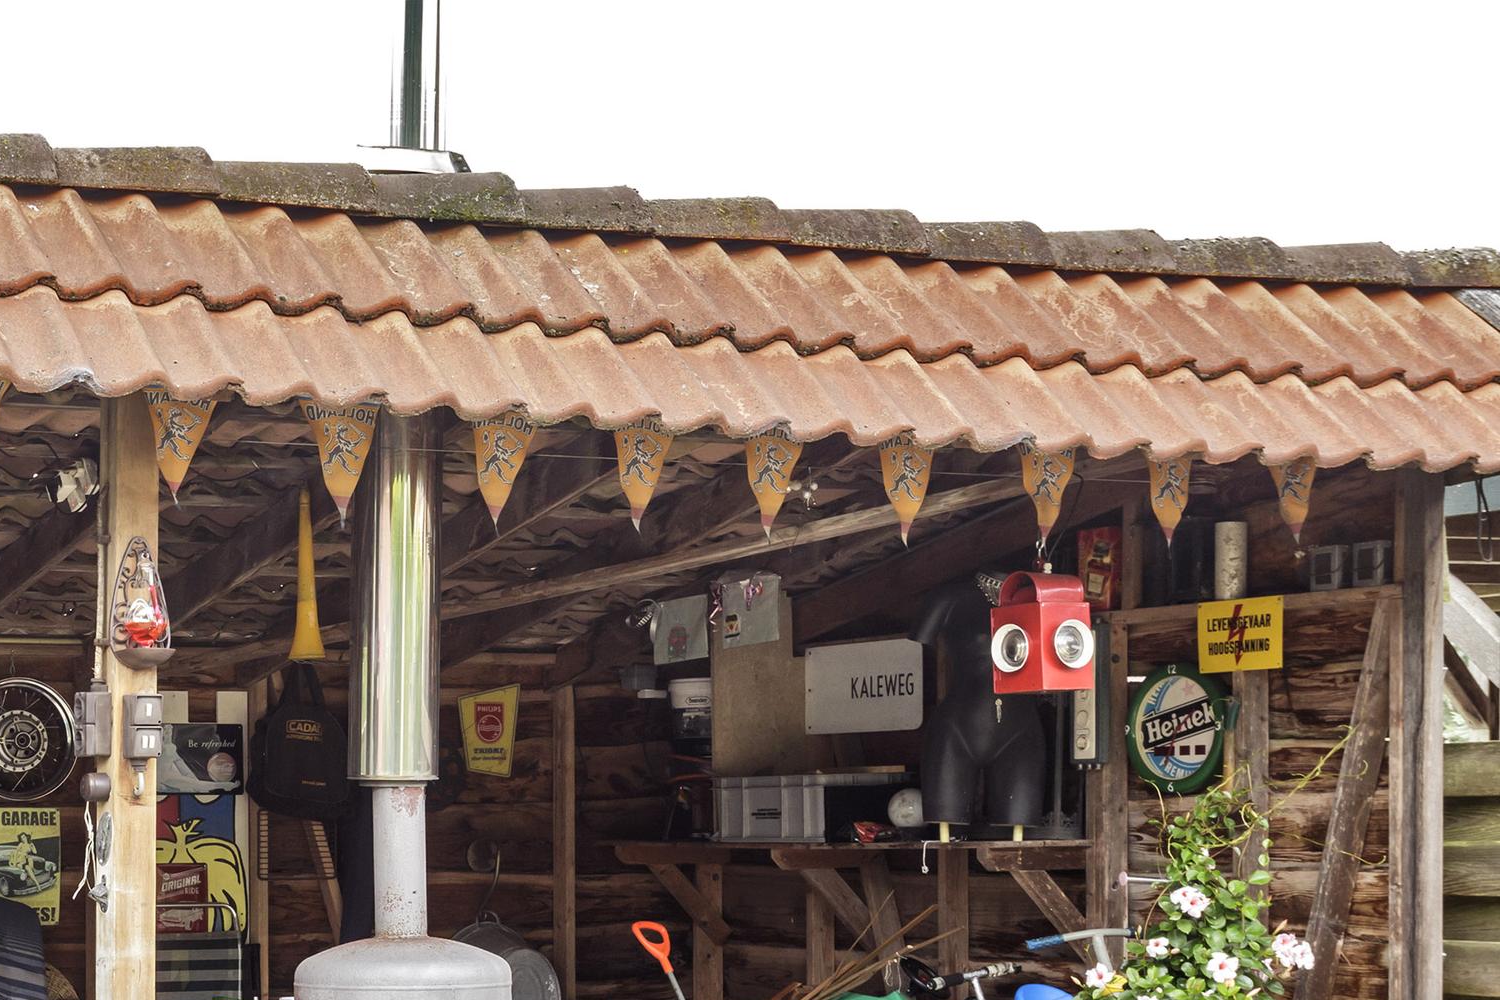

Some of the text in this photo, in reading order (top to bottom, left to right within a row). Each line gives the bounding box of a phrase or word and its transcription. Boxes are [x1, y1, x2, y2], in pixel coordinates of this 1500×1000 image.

[1208, 638, 1270, 656] HOOGSPANNING
[1167, 664, 1177, 674] 12
[851, 673, 915, 699] KALEWEG
[188, 739, 237, 751] Be refreshed
[1167, 782, 1174, 792] 6
[1, 811, 57, 826] GARAGE
[161, 874, 202, 892] ORIGINAL
